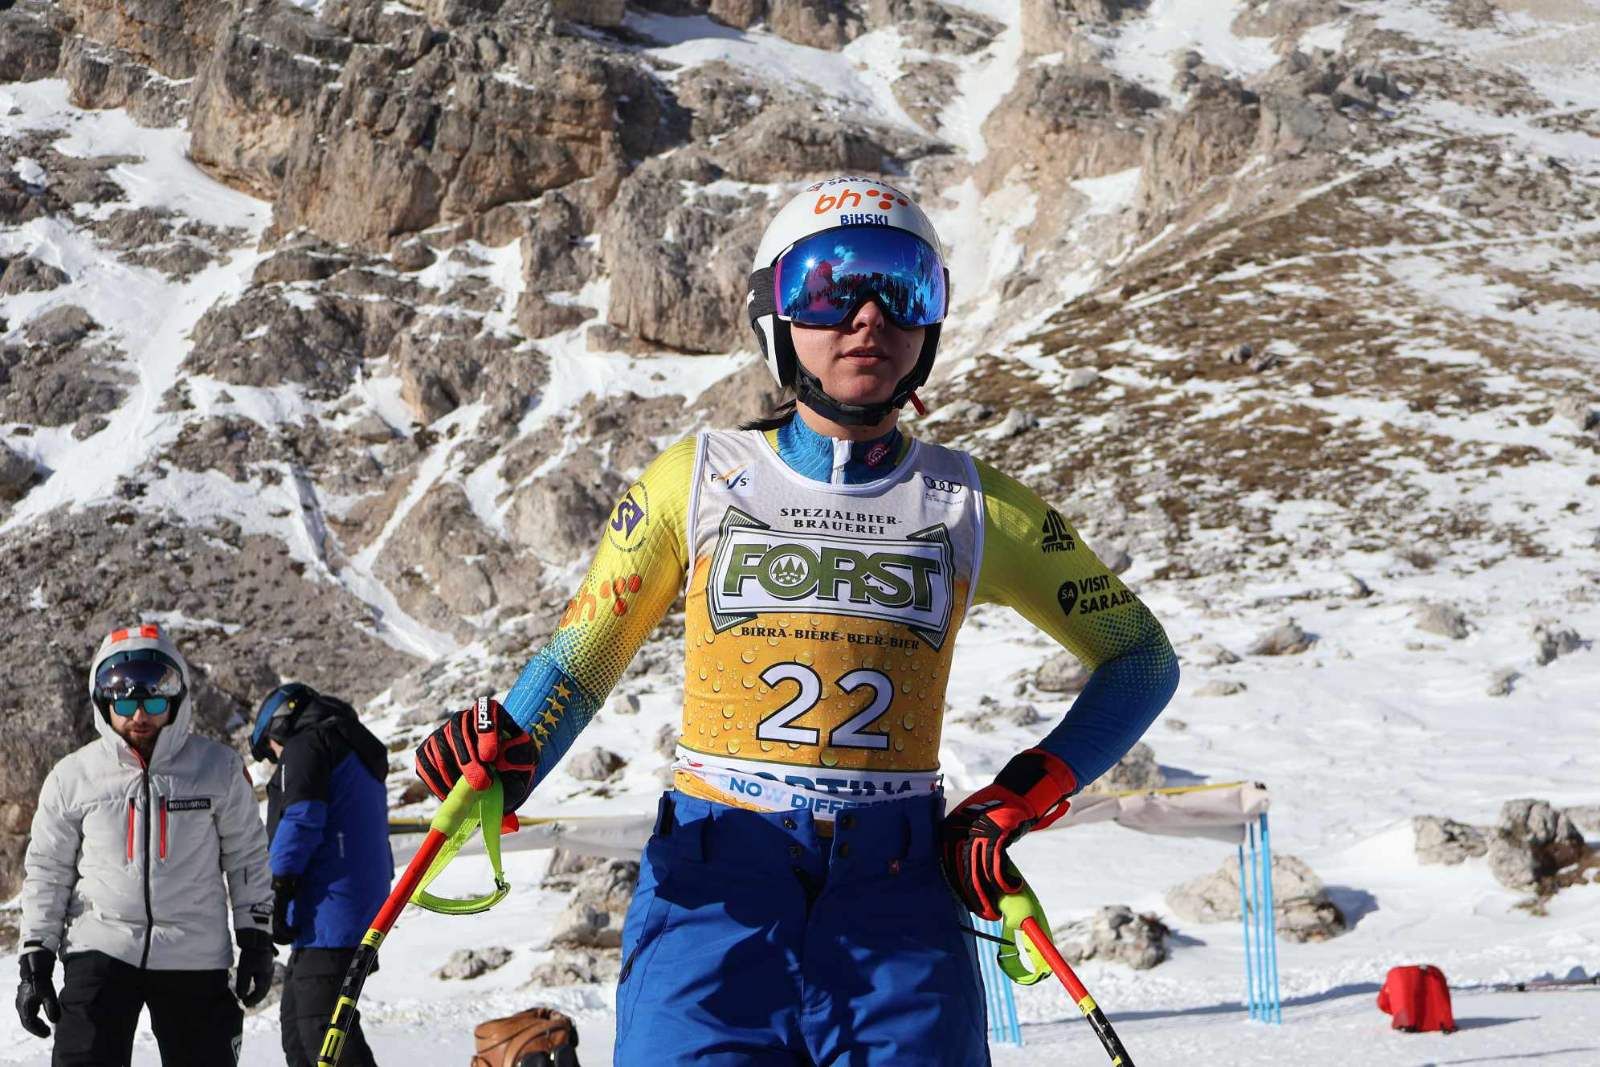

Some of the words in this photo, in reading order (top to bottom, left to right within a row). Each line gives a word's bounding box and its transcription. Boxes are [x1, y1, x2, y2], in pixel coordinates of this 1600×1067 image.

[814, 189, 862, 214] bh
[793, 519, 885, 535] BRAUEREI
[722, 543, 942, 612] FORST
[1079, 575, 1111, 594] VISIT
[756, 661, 895, 751] 22
